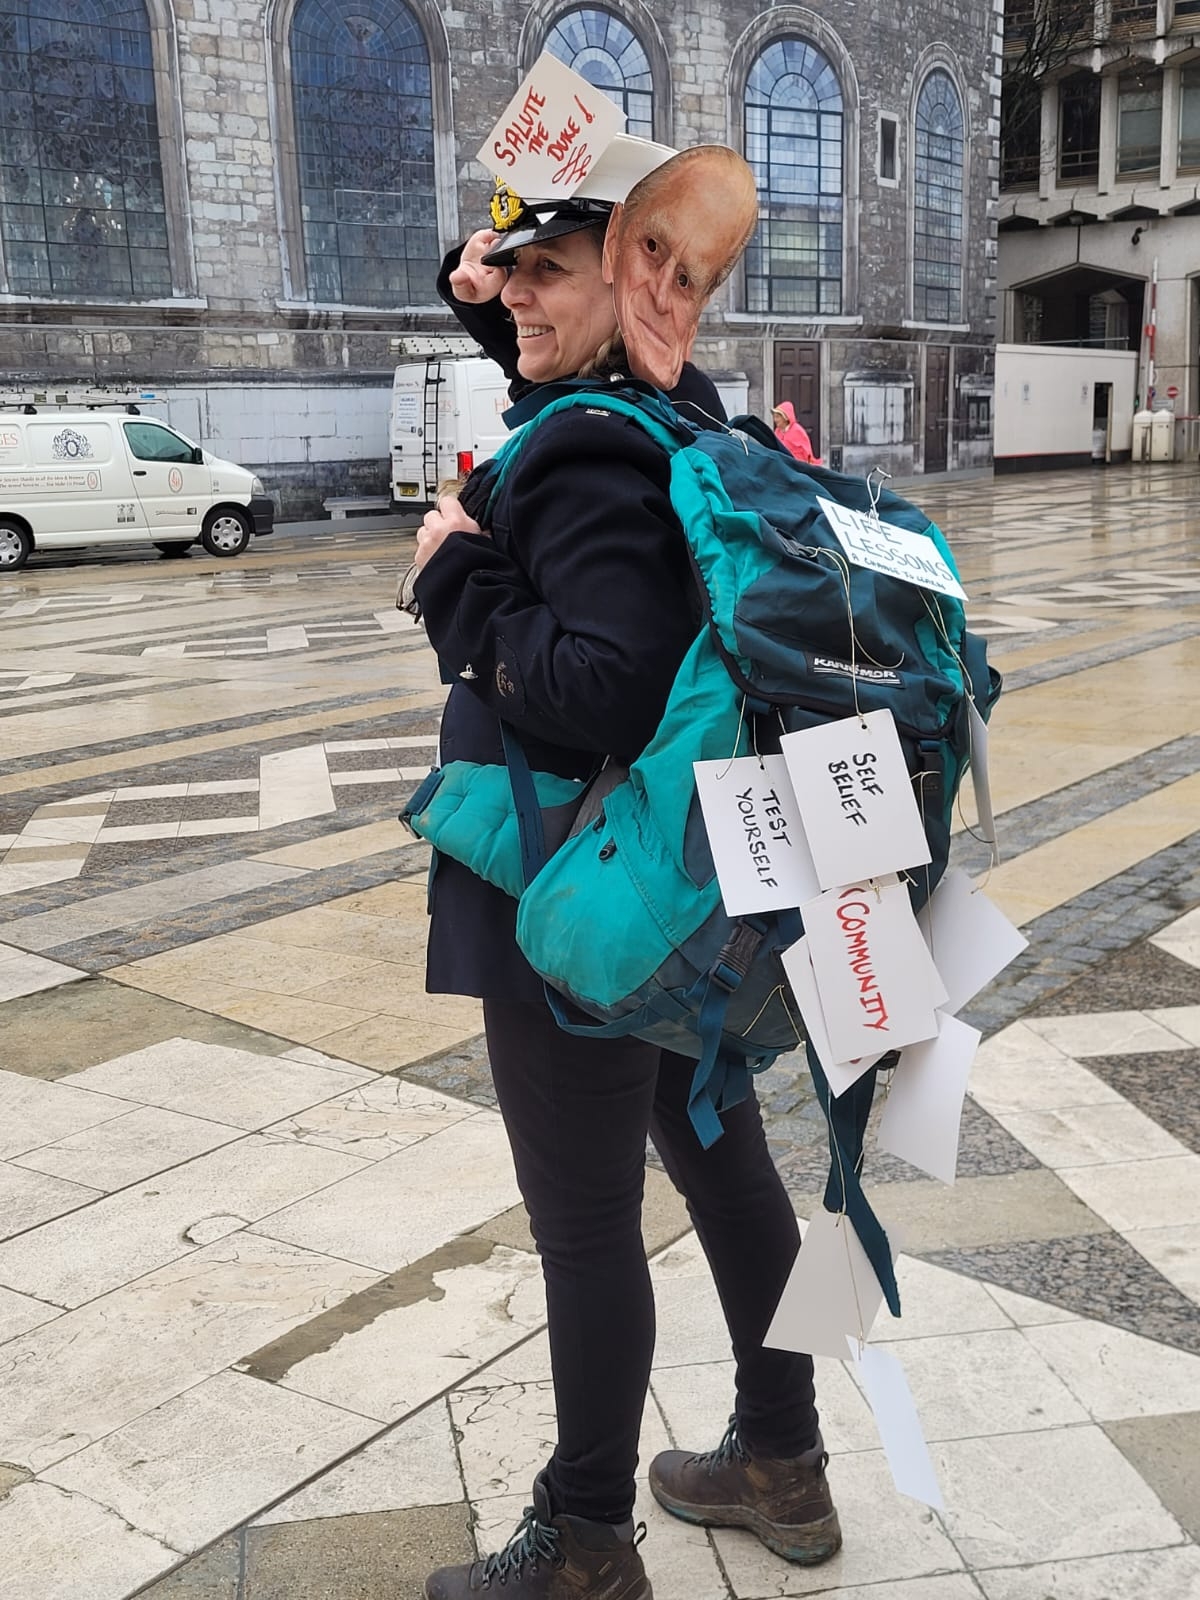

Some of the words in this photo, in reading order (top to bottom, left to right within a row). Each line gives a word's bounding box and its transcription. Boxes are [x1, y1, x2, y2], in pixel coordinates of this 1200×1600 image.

[494, 85, 546, 166] SALUTE
[528, 121, 549, 155] THE
[831, 506, 902, 545] LIFE
[844, 531, 954, 581] LESSONS
[828, 760, 867, 826] BELIEF
[853, 752, 884, 796] SELF
[736, 787, 778, 888] YOURSELF
[762, 788, 792, 847] TEST
